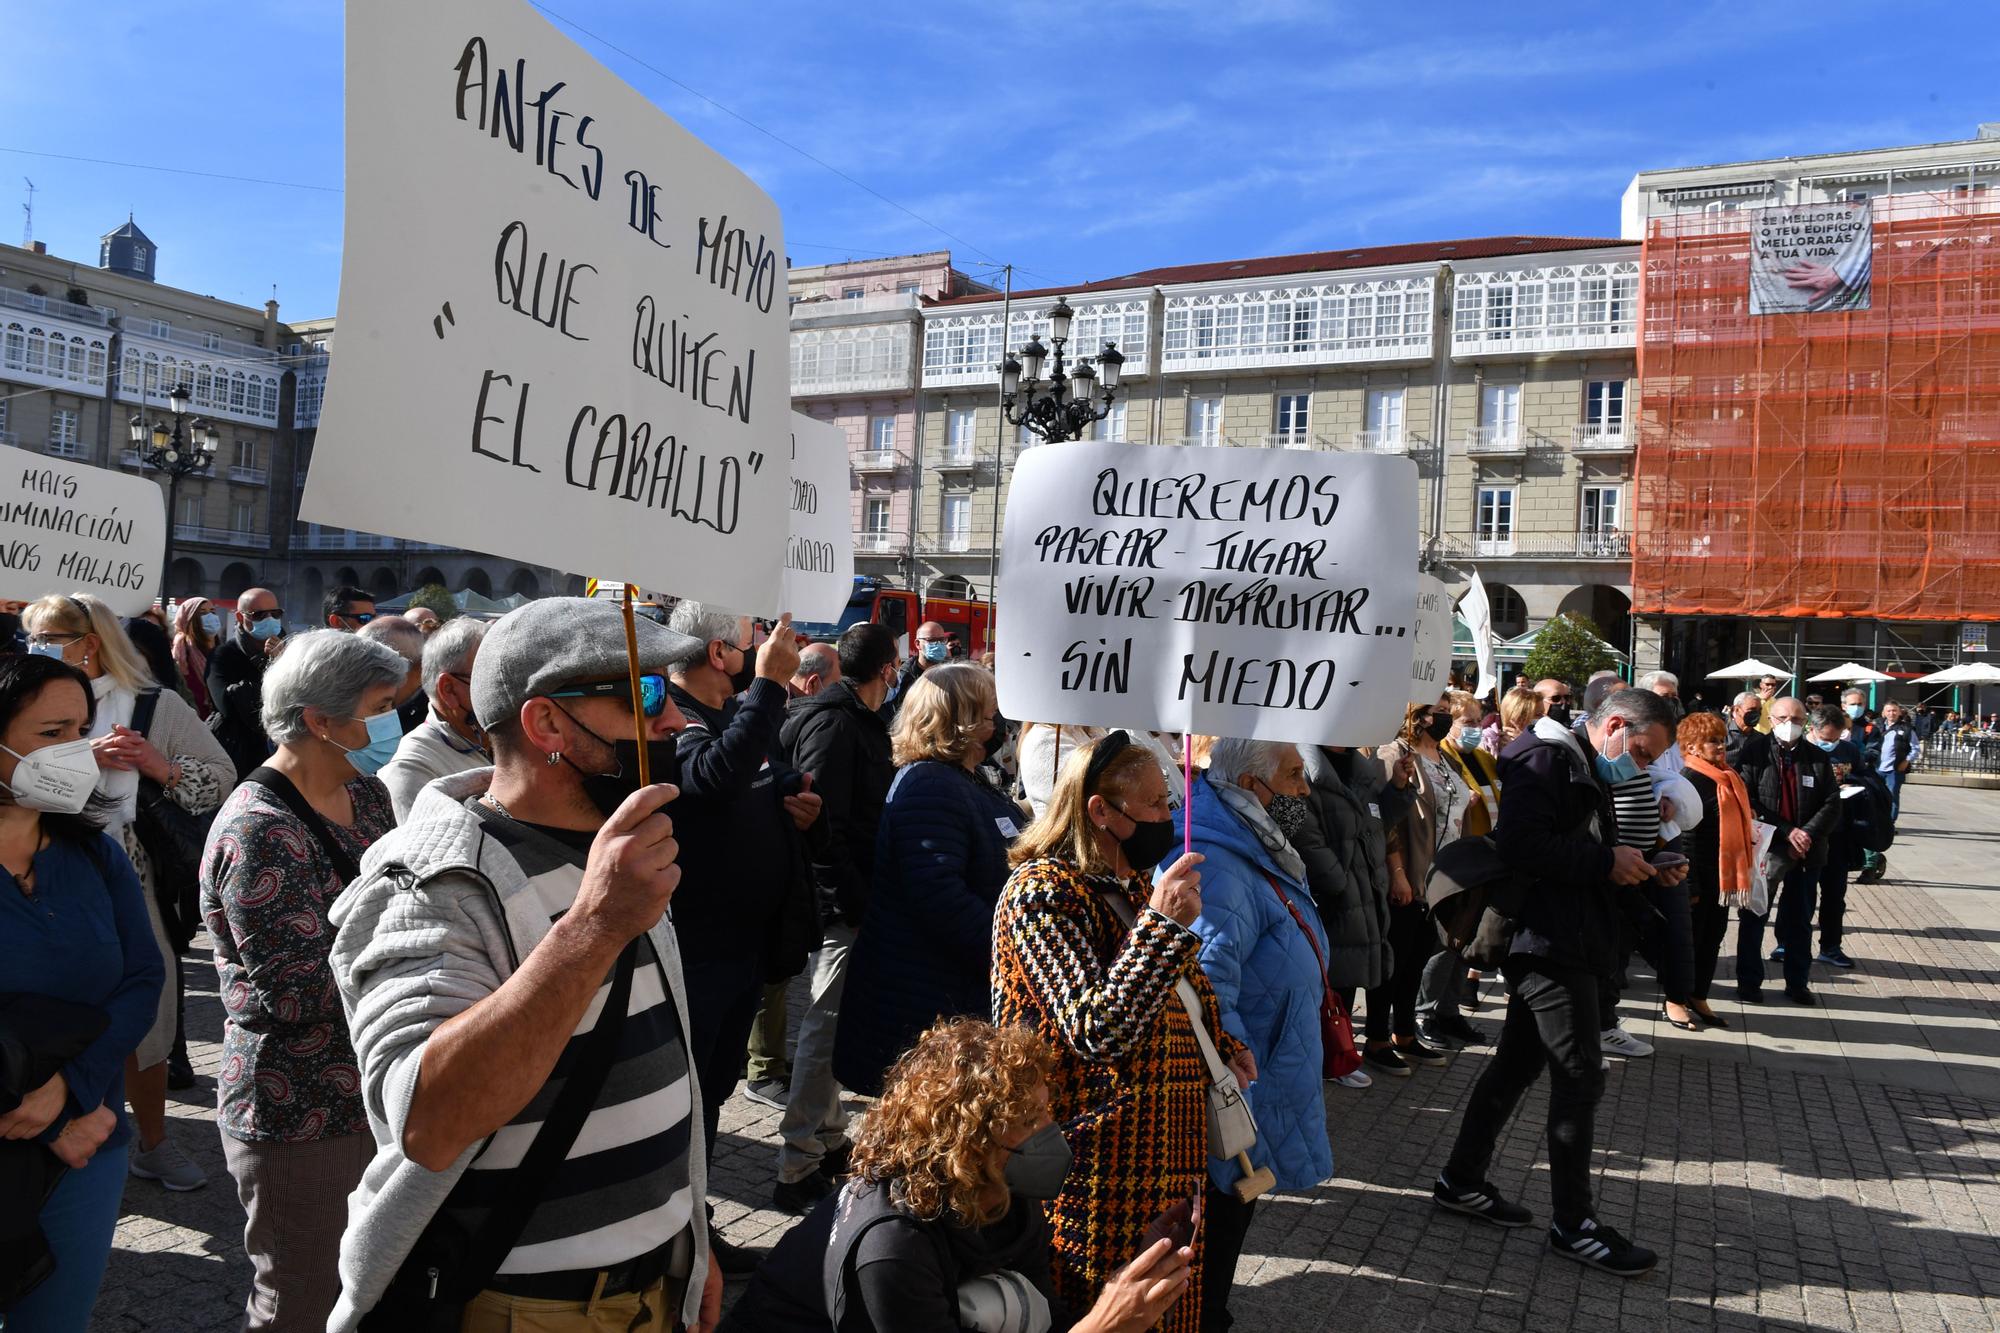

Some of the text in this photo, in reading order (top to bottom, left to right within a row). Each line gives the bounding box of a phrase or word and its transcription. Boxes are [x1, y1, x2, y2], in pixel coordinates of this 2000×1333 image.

[453, 36, 776, 314] ANTES DE MAYO
[1761, 228, 1771, 236] O
[1775, 226, 1800, 236] TEU
[1762, 211, 1853, 226] SE MELLORAS
[1760, 247, 1839, 260] A TUA VIDA.
[1761, 233, 1853, 248] MELLORARÁS
[494, 220, 599, 342] QUE
[21, 469, 78, 500] MAIS
[790, 477, 818, 515] DAD
[1092, 467, 1340, 528] QUEREMOS
[56, 550, 145, 591] MALLOS
[1033, 524, 1169, 570] PASEAR
[1199, 530, 1327, 580] JUGAR
[1064, 574, 1159, 619] VIVIR
[1061, 637, 1336, 711] SIN MIEDO
